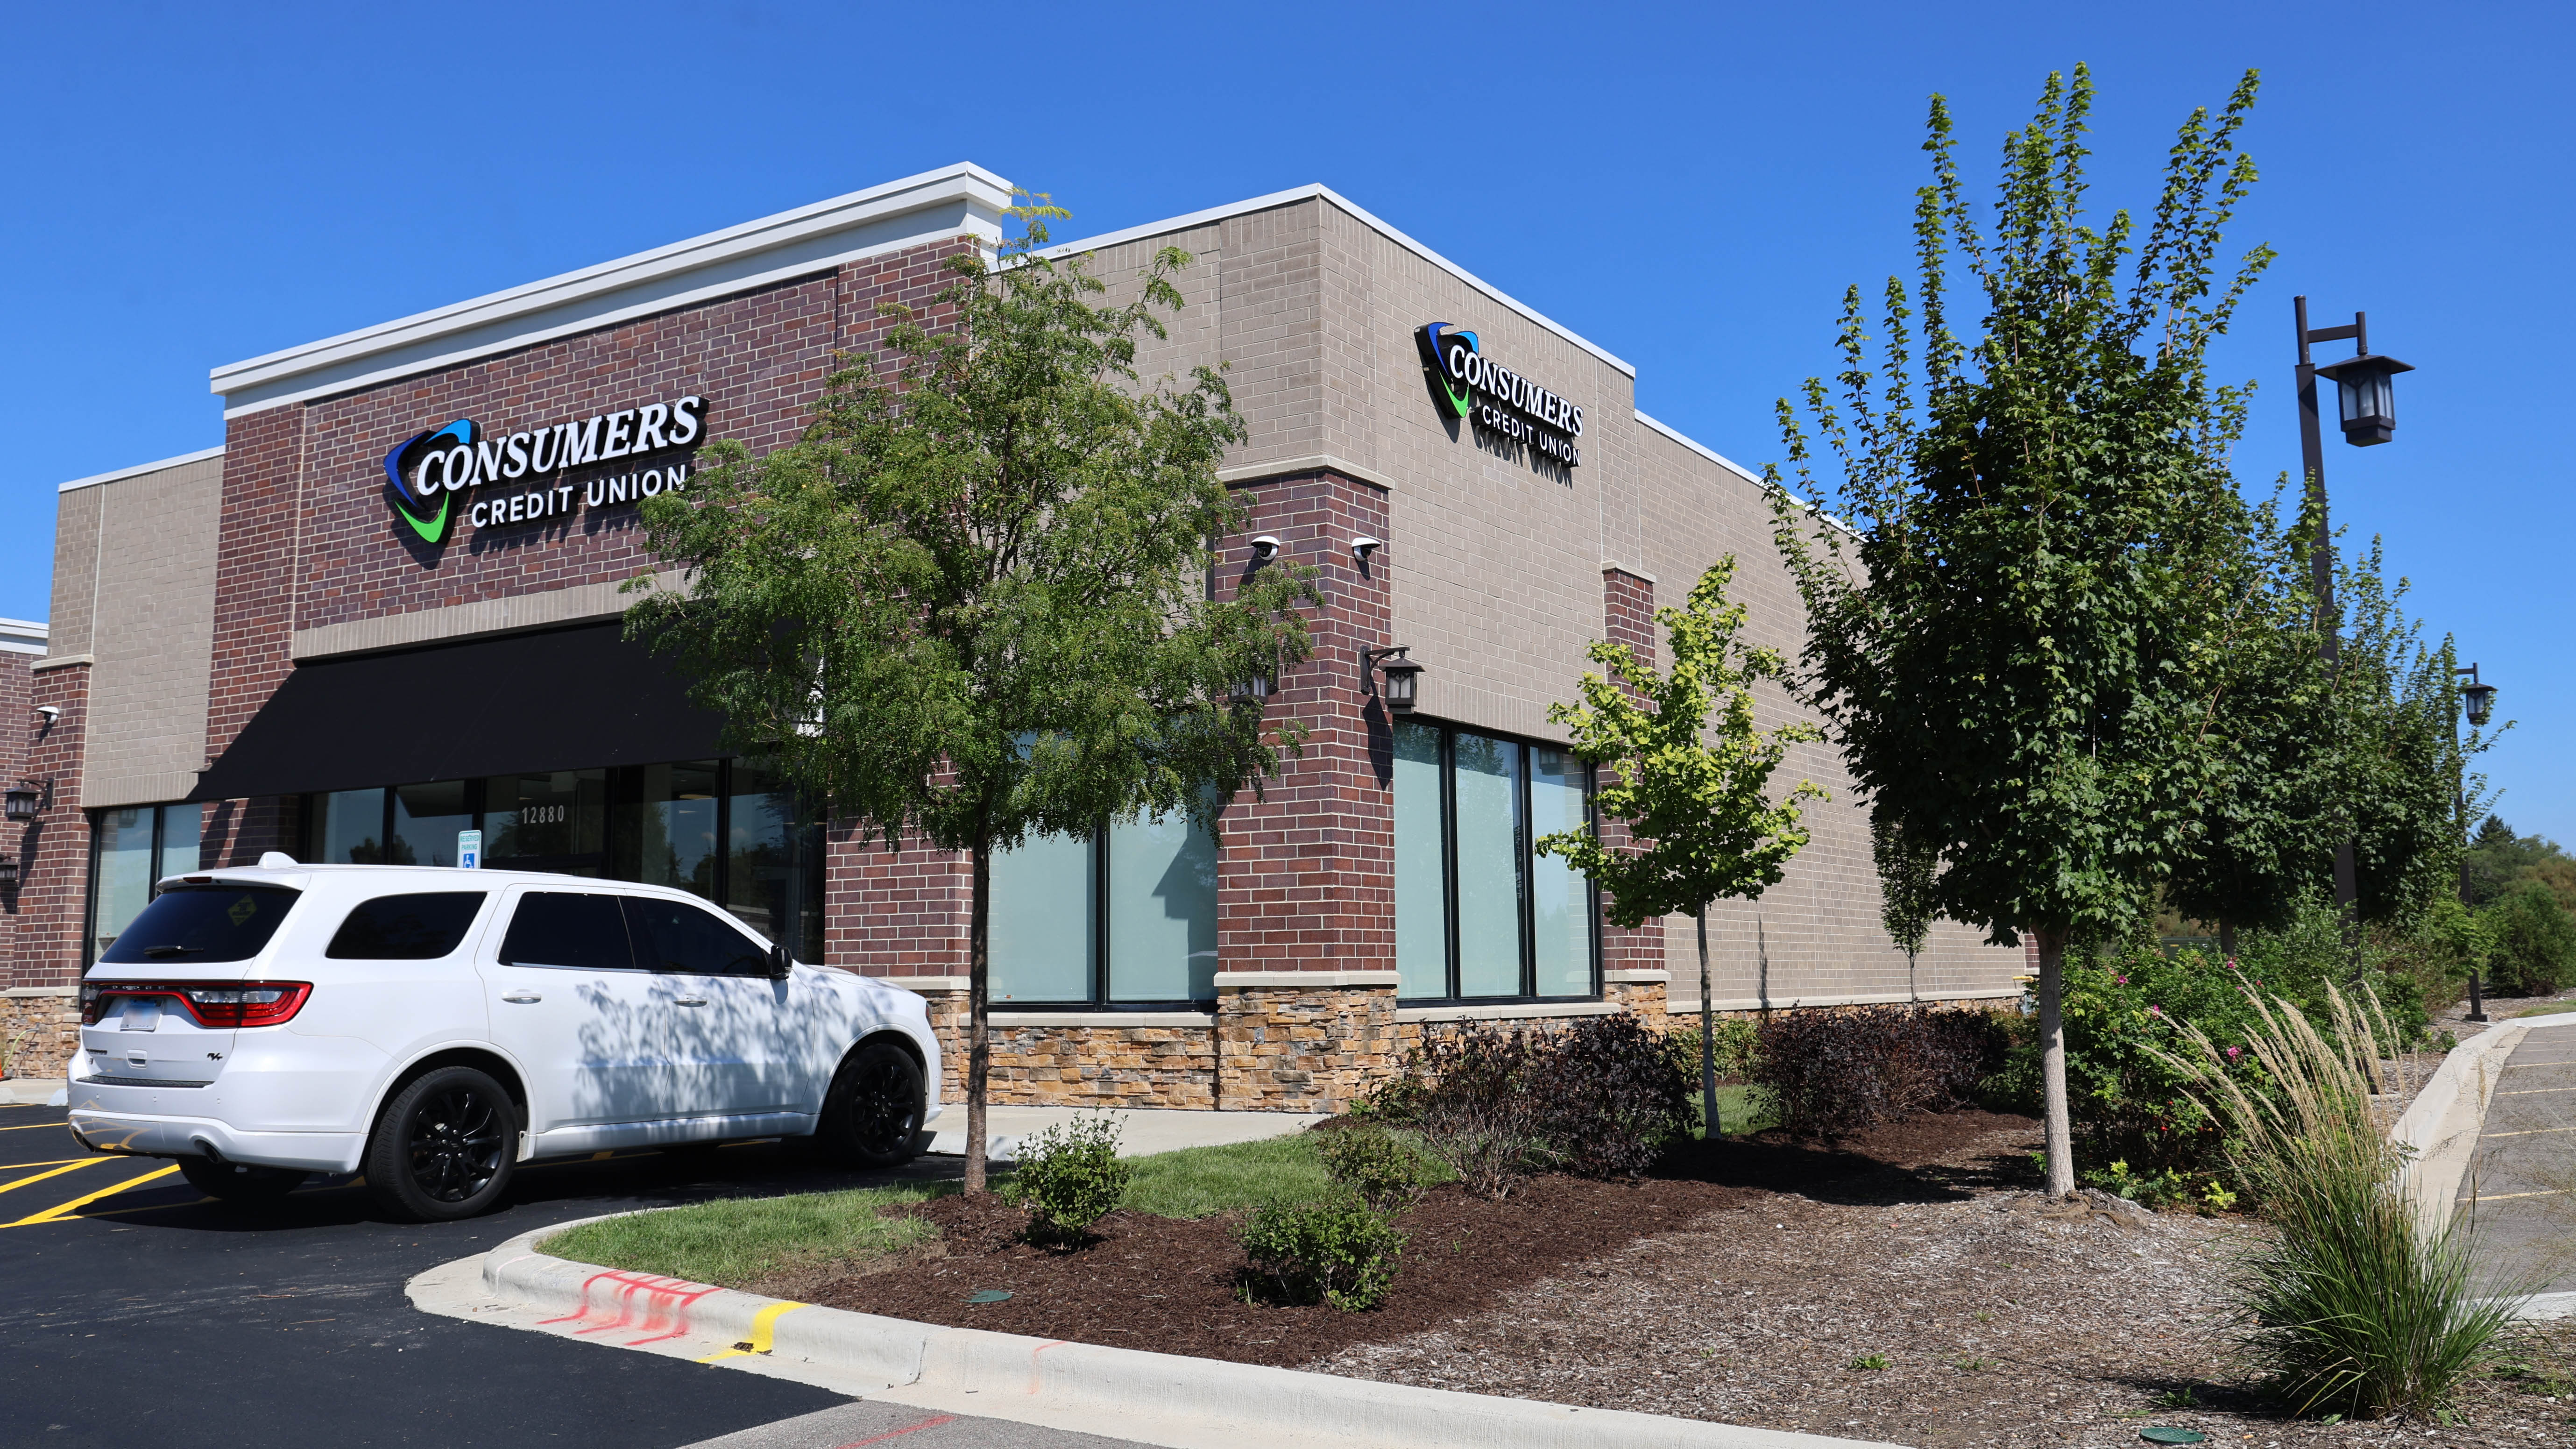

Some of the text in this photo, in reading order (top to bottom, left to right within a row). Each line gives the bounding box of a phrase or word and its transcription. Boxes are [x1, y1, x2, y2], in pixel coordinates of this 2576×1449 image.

[1450, 344, 1584, 437] CONSUMERS
[416, 395, 700, 496] CONSUMERS
[1482, 405, 1581, 467] CREDIT UNION
[471, 464, 686, 528] CREDIT UNION
[522, 805, 564, 824] 12880
